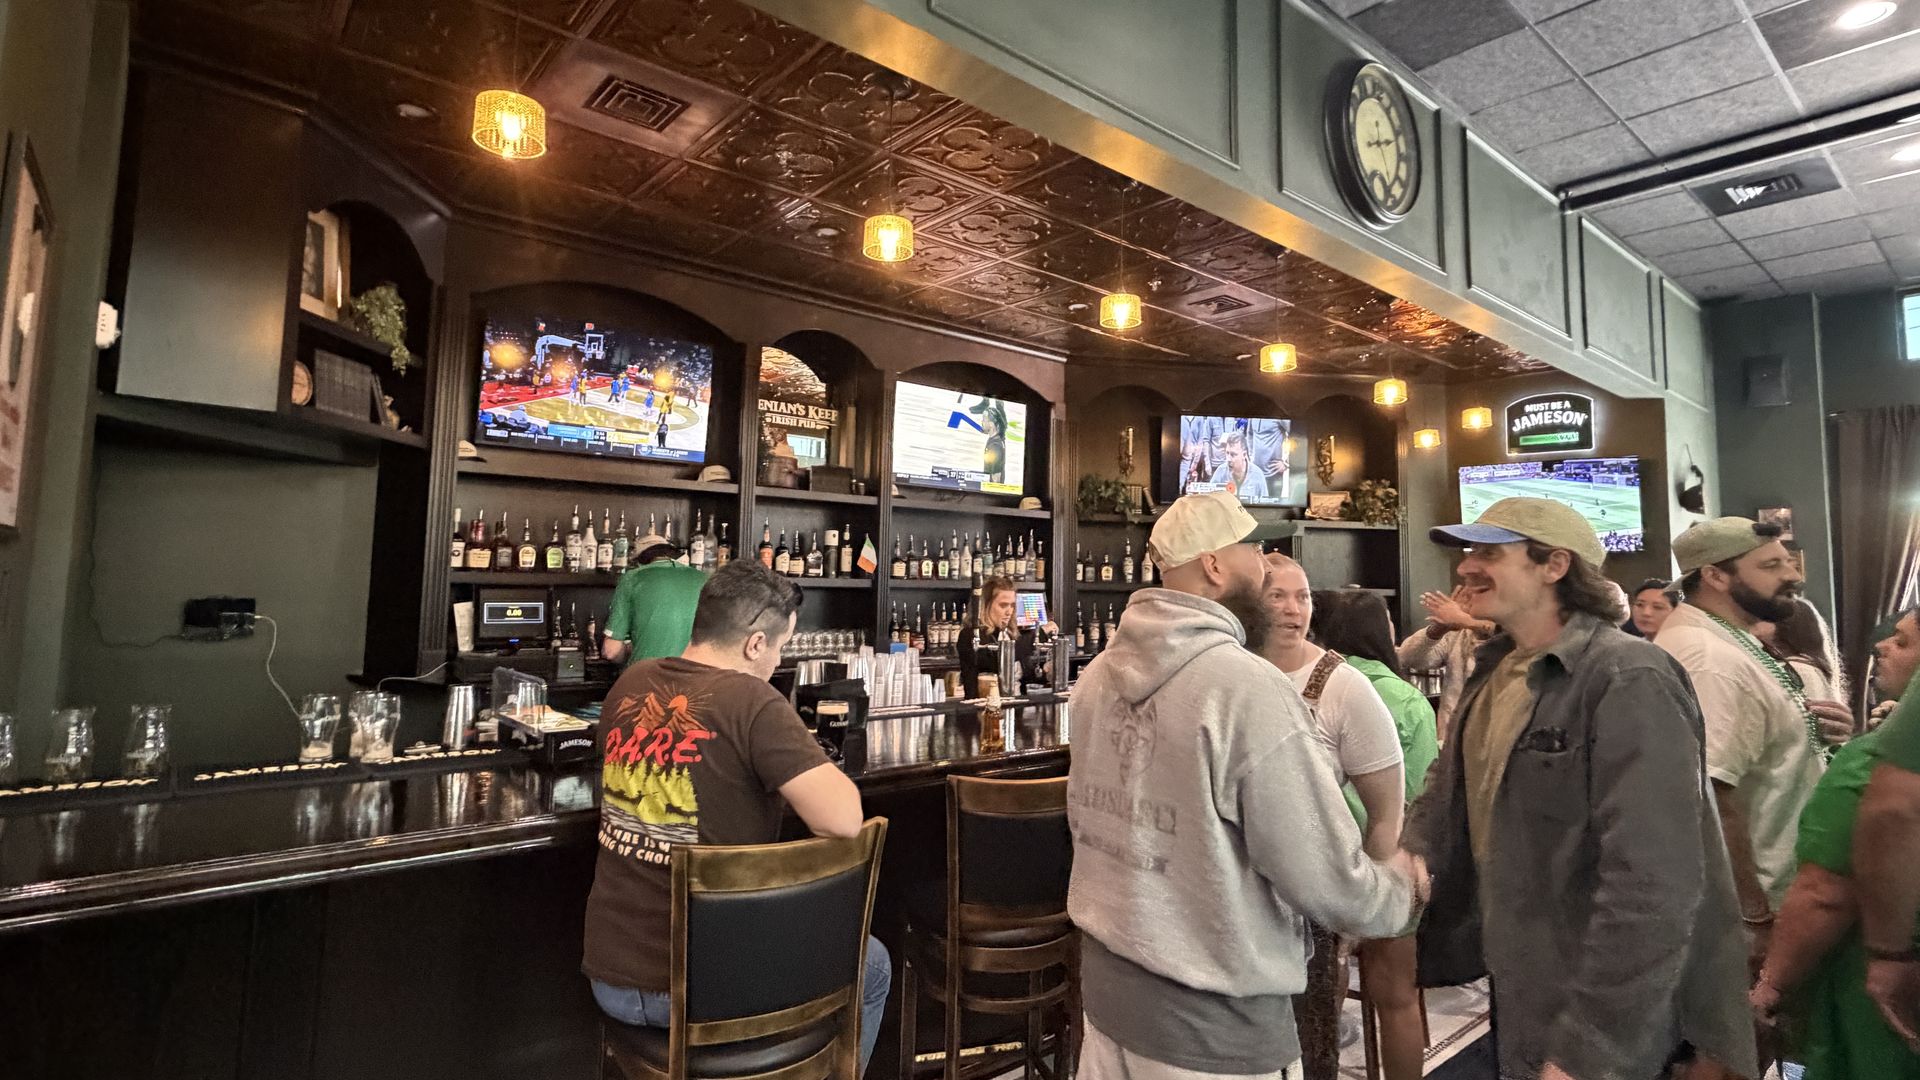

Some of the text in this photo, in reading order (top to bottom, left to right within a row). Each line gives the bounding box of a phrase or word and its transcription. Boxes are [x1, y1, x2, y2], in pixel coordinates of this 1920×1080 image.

[759, 399, 806, 416] ENIAN'S
[1524, 400, 1571, 413] MUST BE A
[772, 415, 816, 429] IRISH PUB
[1512, 410, 1586, 432] JAMESON
[559, 738, 593, 750] JAMESON
[658, 841, 671, 853] M
[617, 844, 633, 857] OF
[636, 849, 672, 866] CHOI
